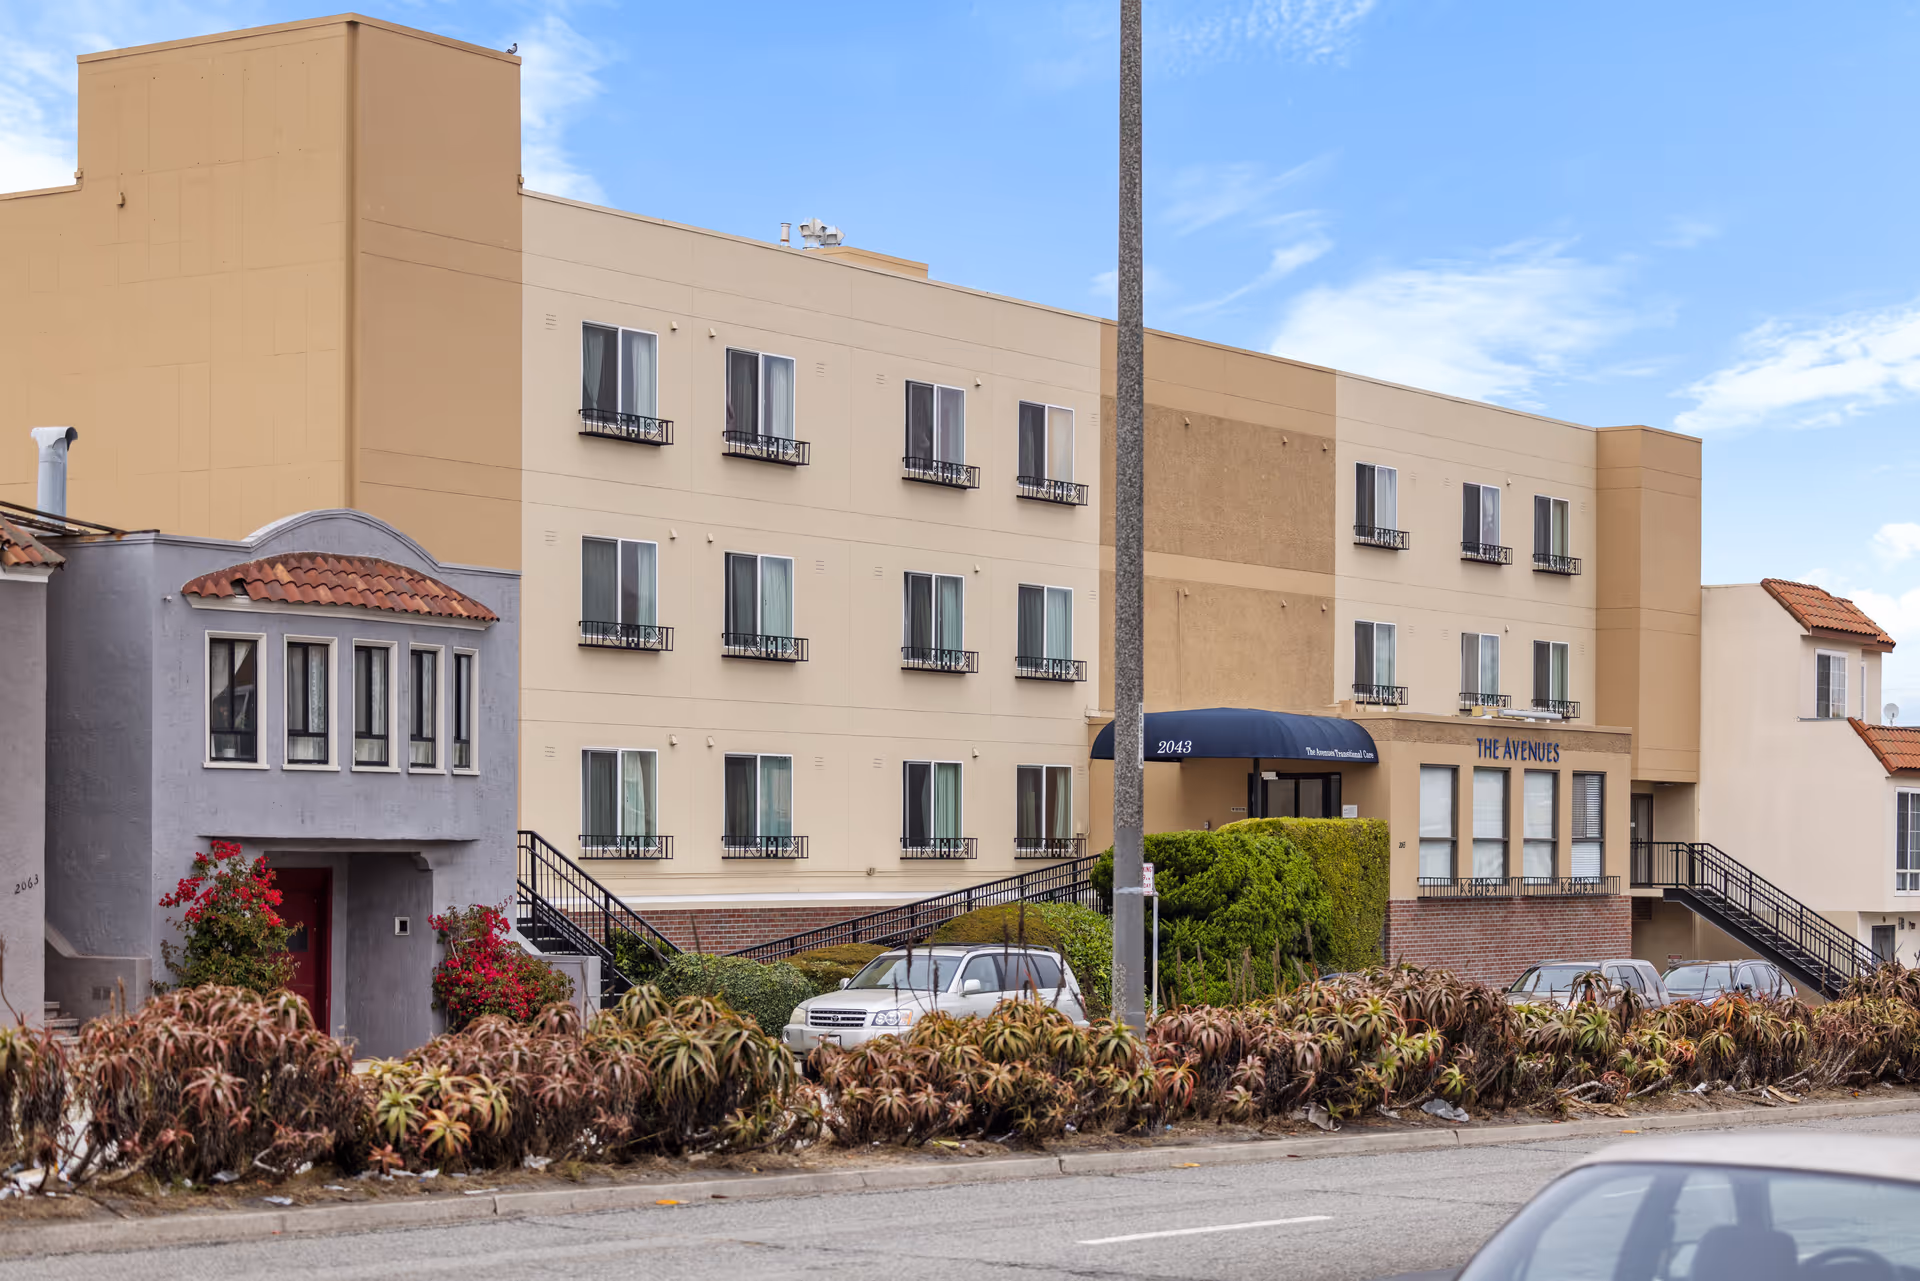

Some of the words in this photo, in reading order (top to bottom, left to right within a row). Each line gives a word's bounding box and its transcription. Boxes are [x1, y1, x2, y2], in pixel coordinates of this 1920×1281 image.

[1156, 740, 1192, 754] 2043
[1305, 746, 1316, 756] The
[1316, 747, 1335, 757] Avenues
[1334, 748, 1363, 759] Transitional
[1363, 749, 1375, 759] Care
[1476, 737, 1500, 760] THE
[1502, 736, 1560, 763] AVENUES
[14, 873, 39, 895] 2063
